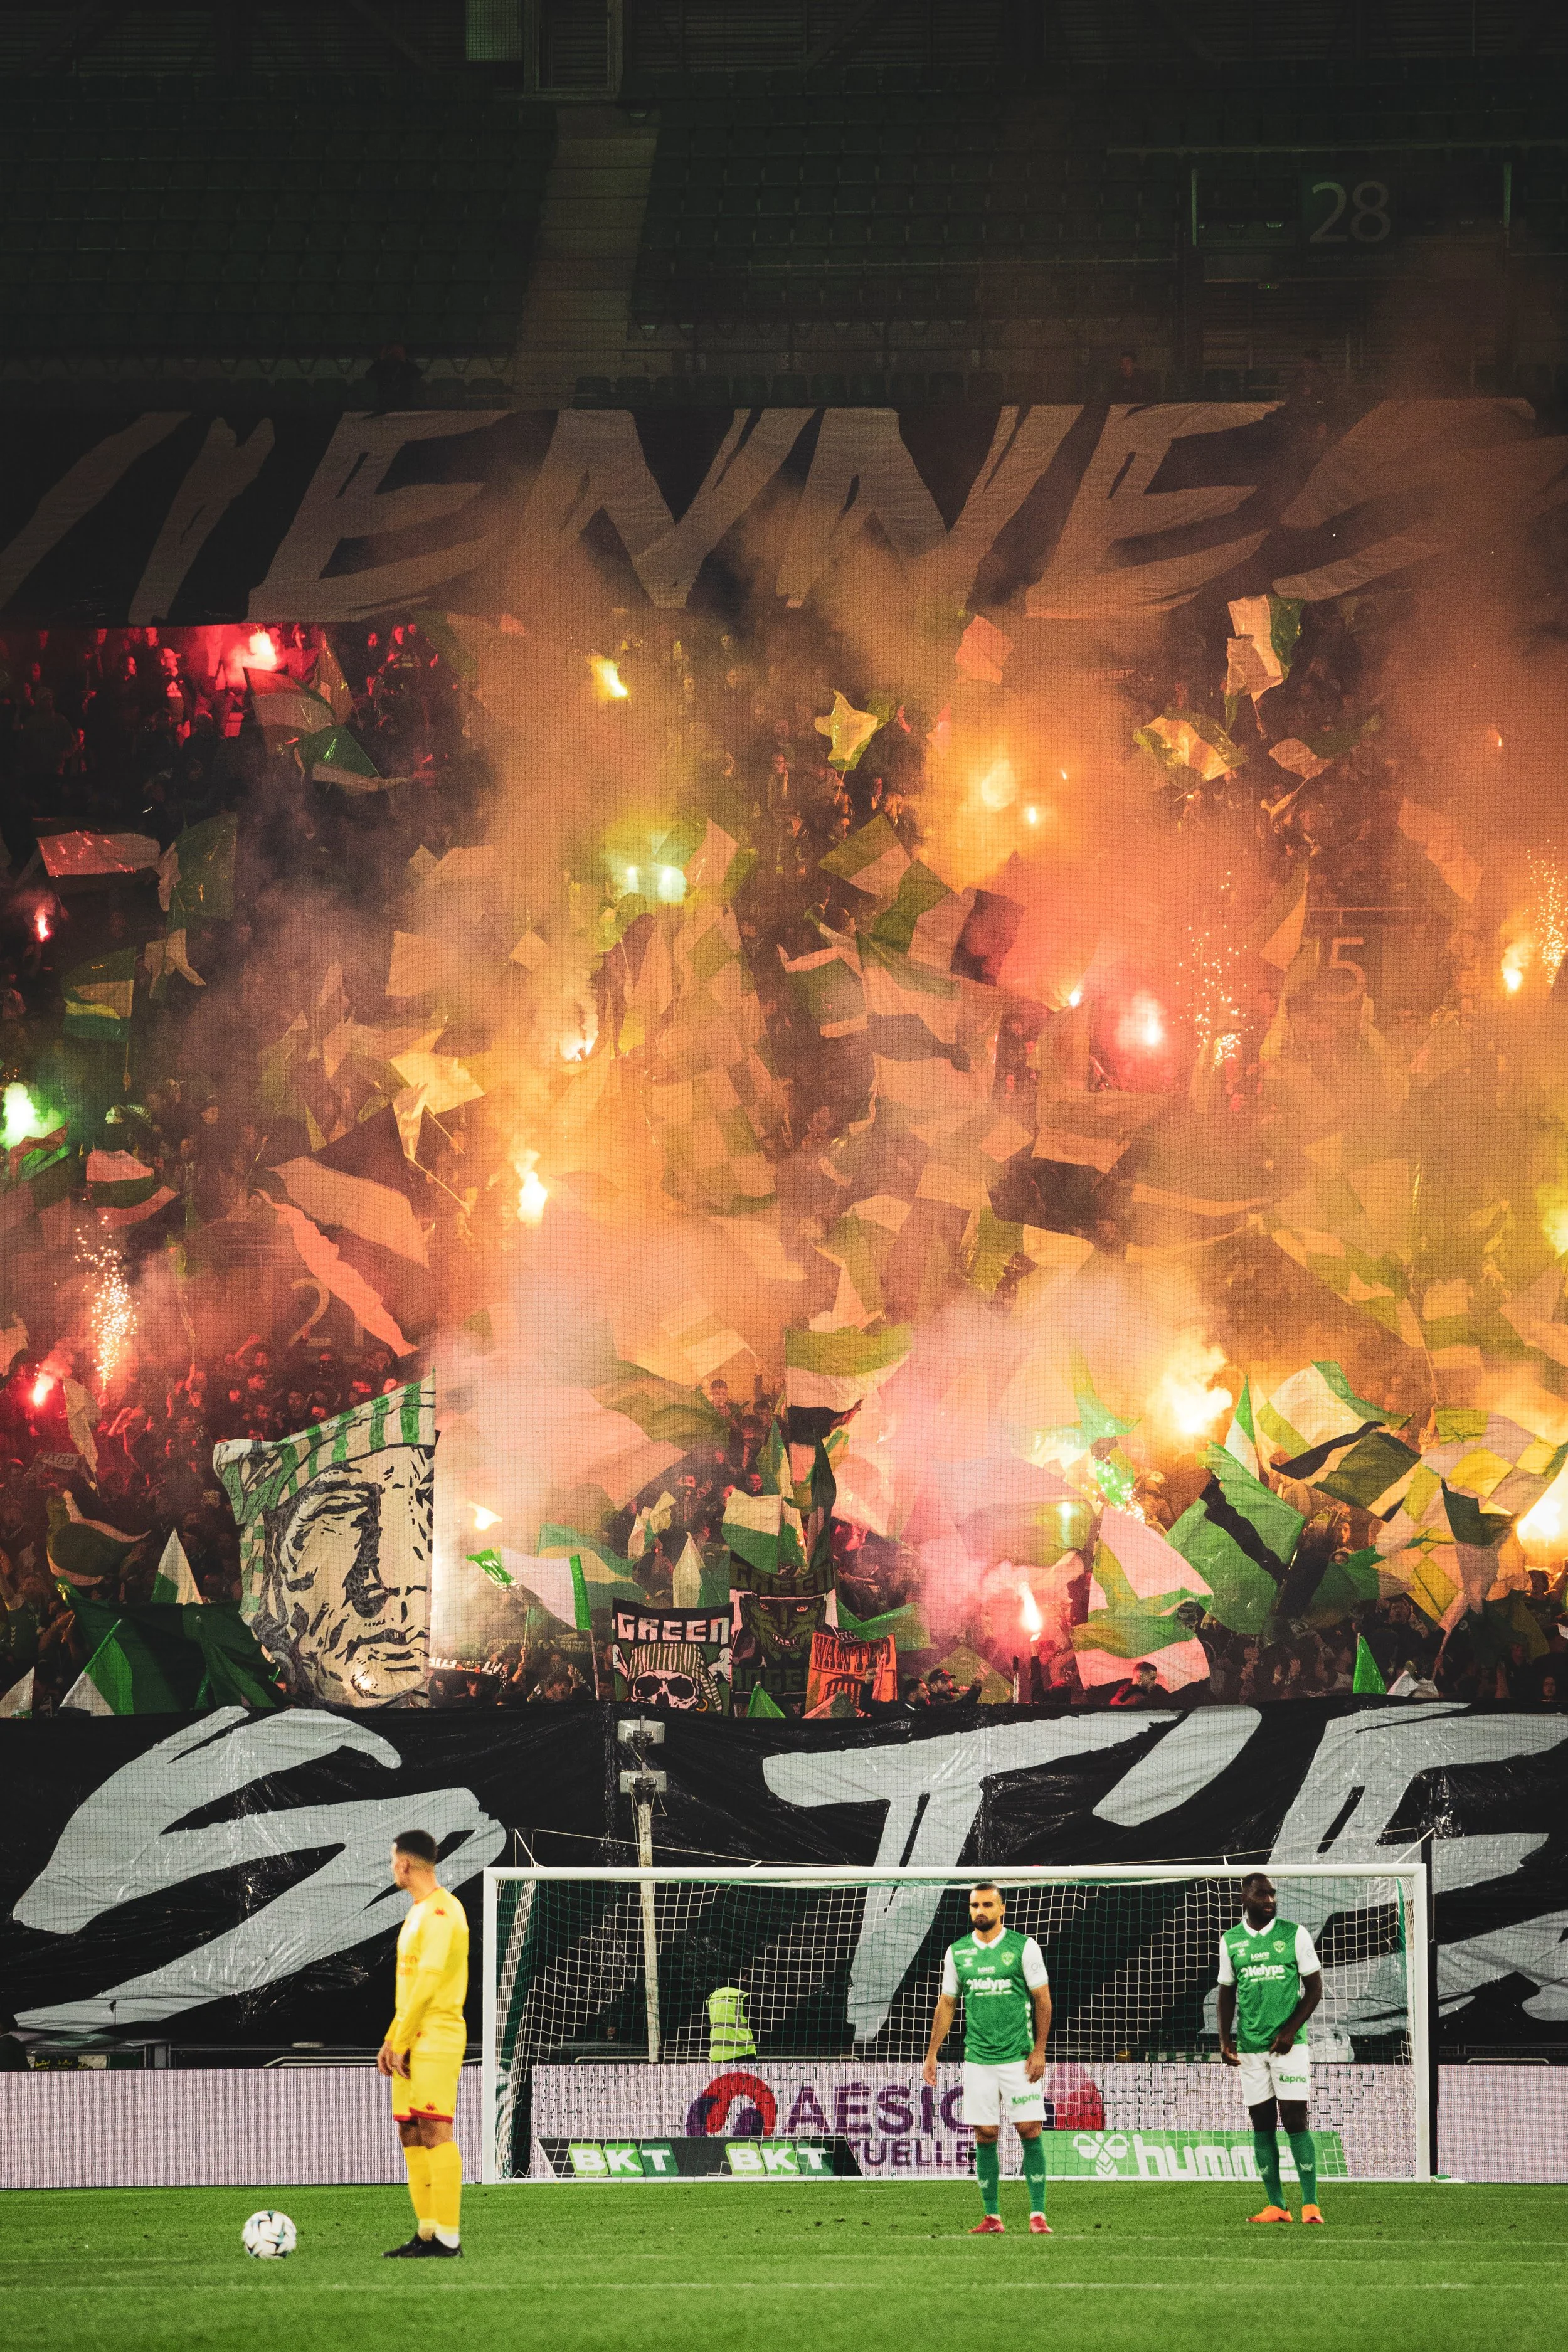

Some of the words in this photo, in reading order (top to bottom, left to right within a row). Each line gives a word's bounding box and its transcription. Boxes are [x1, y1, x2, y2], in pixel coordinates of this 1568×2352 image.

[1310, 180, 1391, 243] 28
[1313, 936, 1367, 1002] 5
[617, 1612, 730, 1644] GREEN
[972, 1977, 1012, 1991] Kelyps
[1248, 1963, 1285, 1977] Kelyps
[571, 2148, 670, 2172] BKT
[728, 2147, 827, 2171] BKT
[1133, 2134, 1298, 2177] humme
